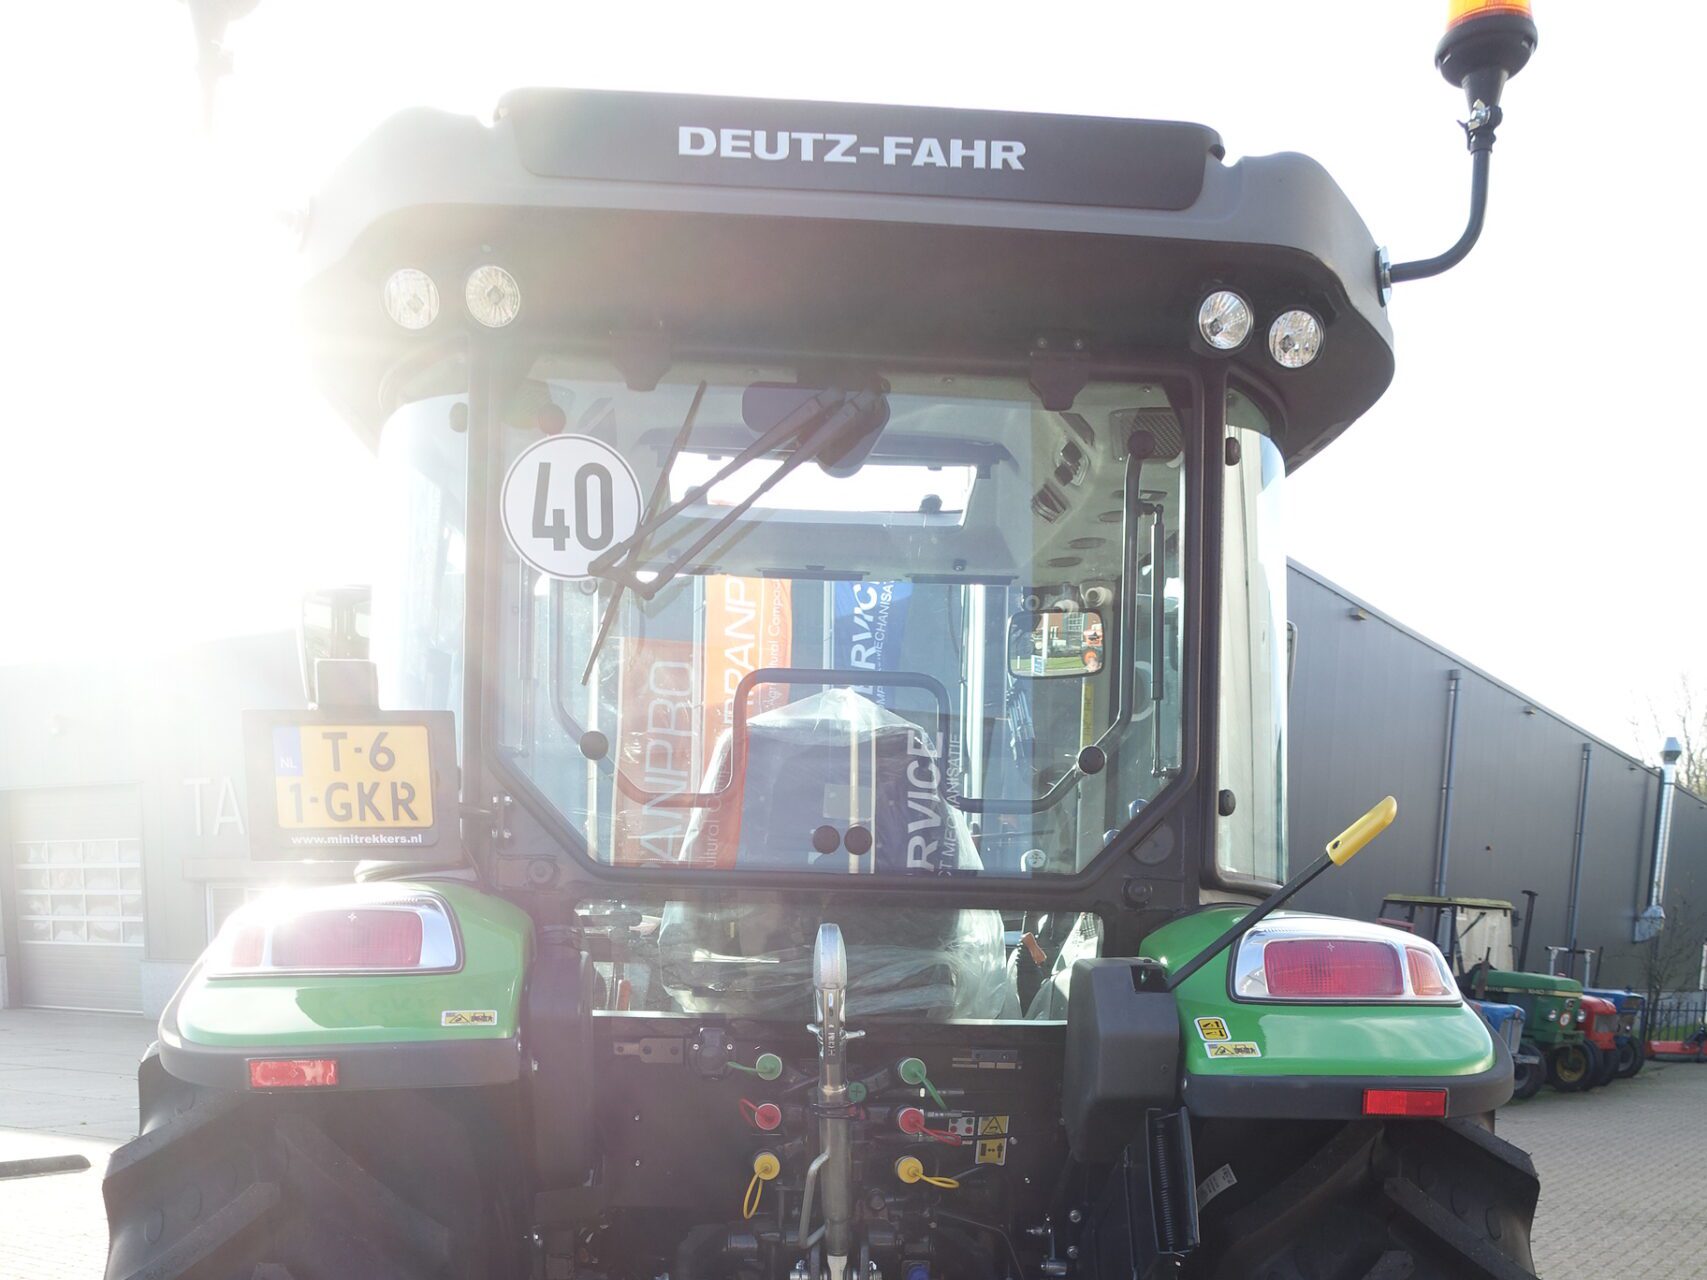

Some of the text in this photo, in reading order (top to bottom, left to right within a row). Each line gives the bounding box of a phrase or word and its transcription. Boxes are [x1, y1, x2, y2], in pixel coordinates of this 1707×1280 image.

[678, 126, 1027, 171] DEUTZ-FAHR
[532, 462, 614, 552] 40
[767, 579, 783, 637] Compac
[874, 581, 895, 660] MECHANISA
[280, 757, 297, 769] NL
[322, 731, 396, 772] T-6
[289, 781, 419, 823] 1-GKR
[291, 833, 423, 845] www.minitrekkers.nl
